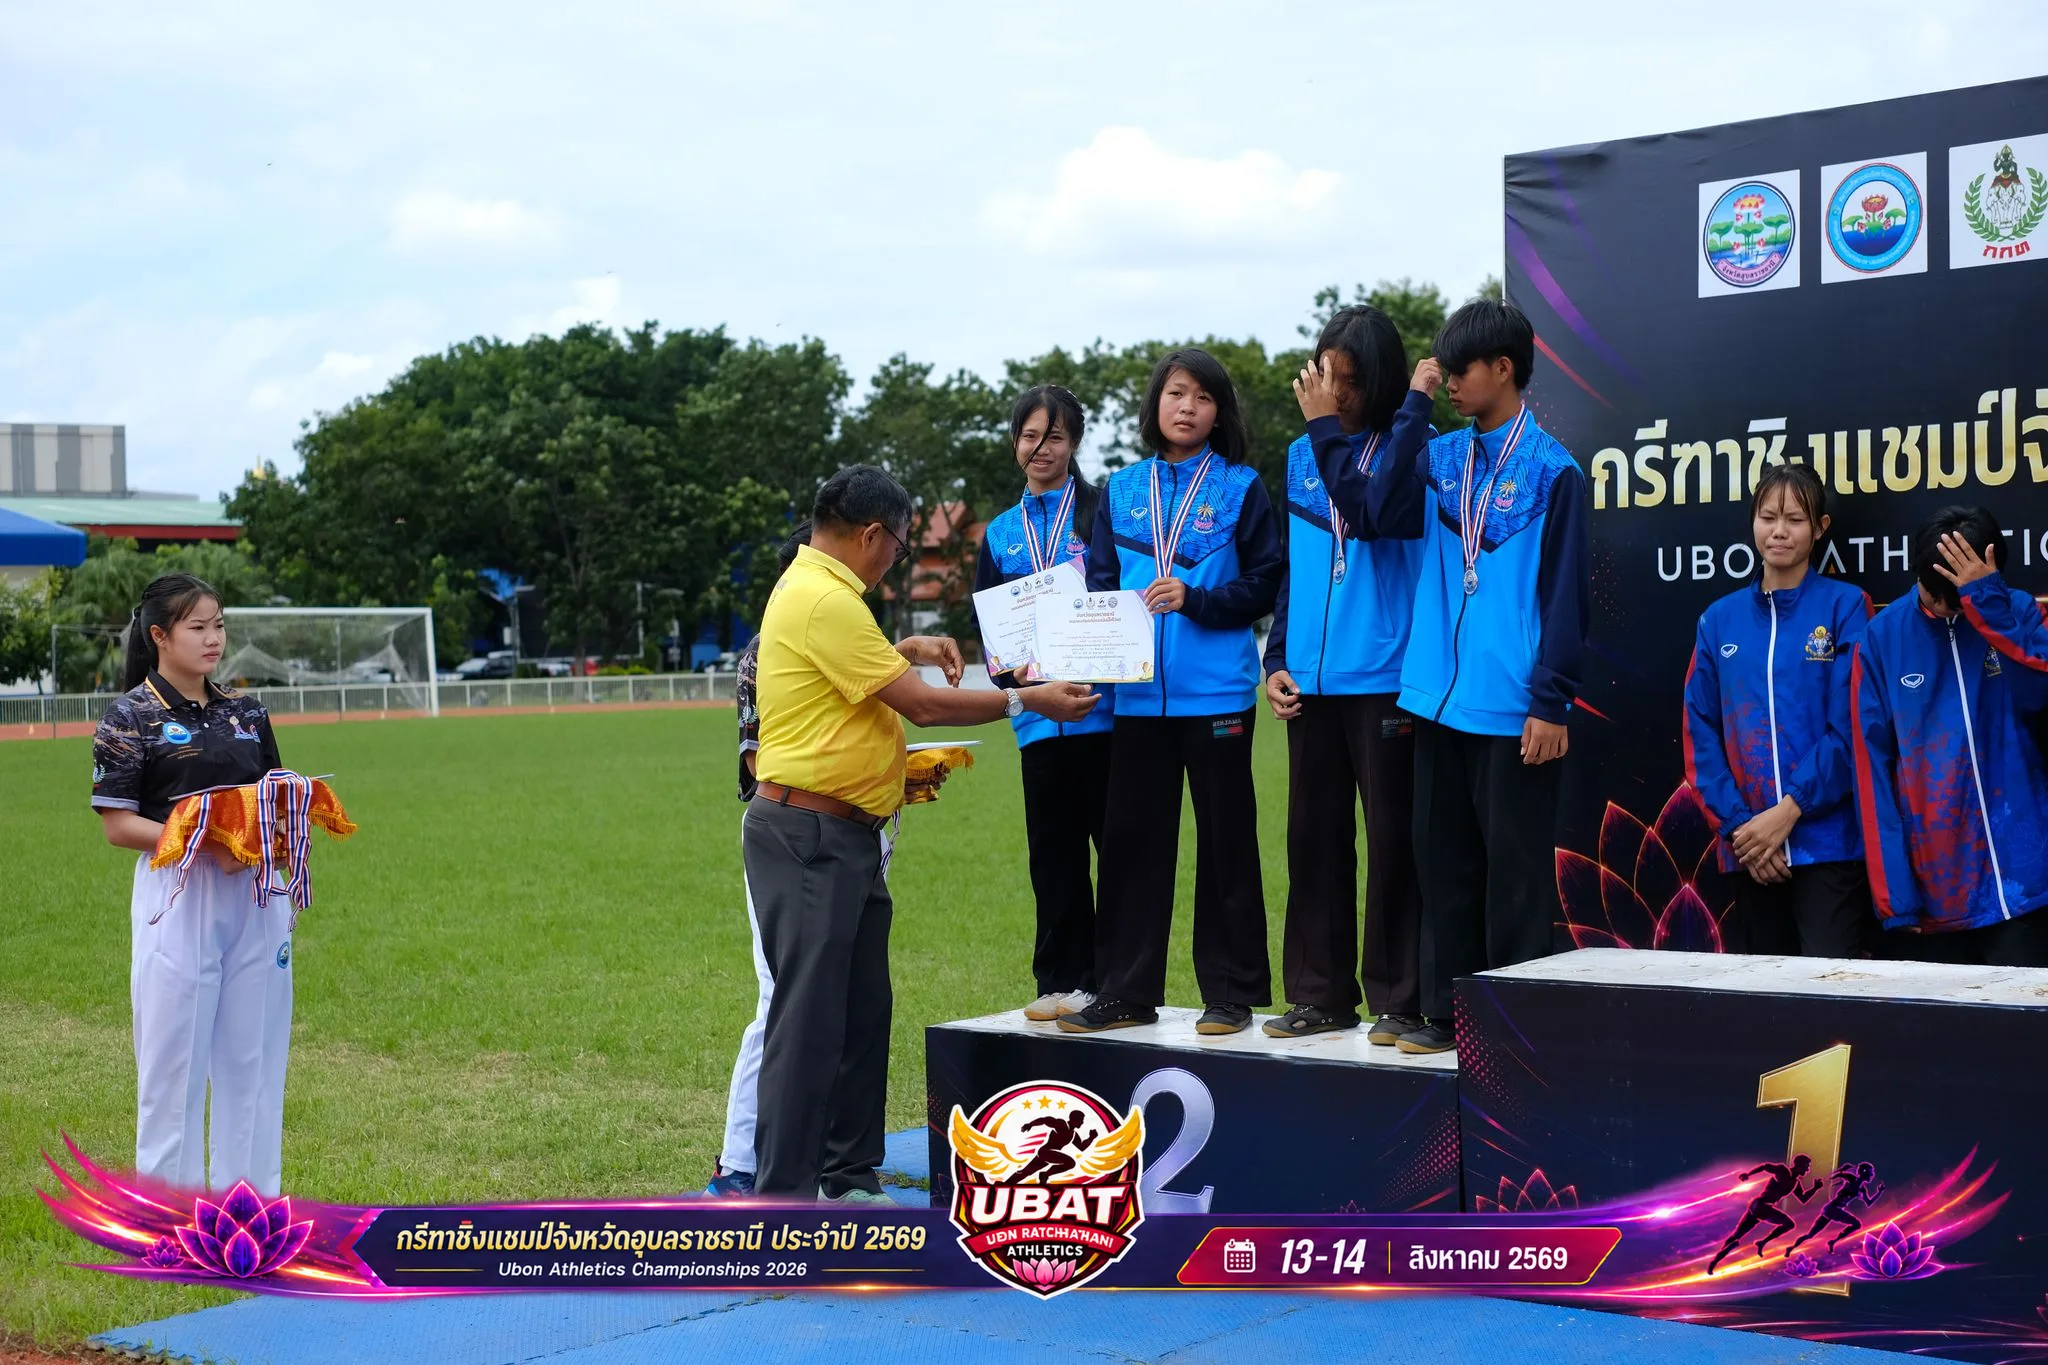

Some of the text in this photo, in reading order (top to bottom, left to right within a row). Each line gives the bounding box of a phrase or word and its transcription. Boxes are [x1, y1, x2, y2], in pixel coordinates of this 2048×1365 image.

[1983, 241, 2030, 259] กกท
[1657, 543, 1755, 582] UBO
[1128, 1067, 1215, 1214] 2
